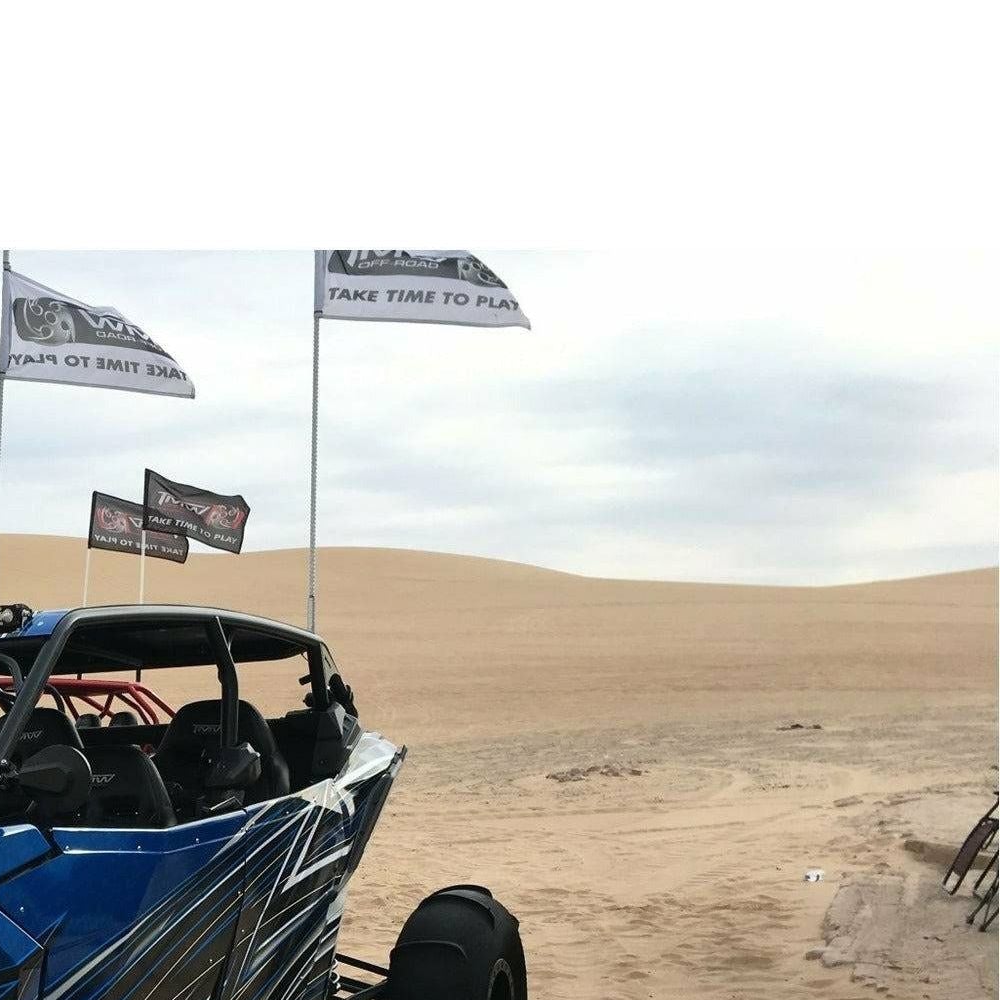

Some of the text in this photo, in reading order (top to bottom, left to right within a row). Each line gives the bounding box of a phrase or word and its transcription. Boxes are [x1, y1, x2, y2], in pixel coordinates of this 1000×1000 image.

[328, 287, 520, 311] TAKE TIME TO PLAY
[148, 515, 172, 526] TAKE
[175, 519, 198, 532] TIME
[200, 527, 211, 538] TO
[213, 534, 238, 545] PLAY
